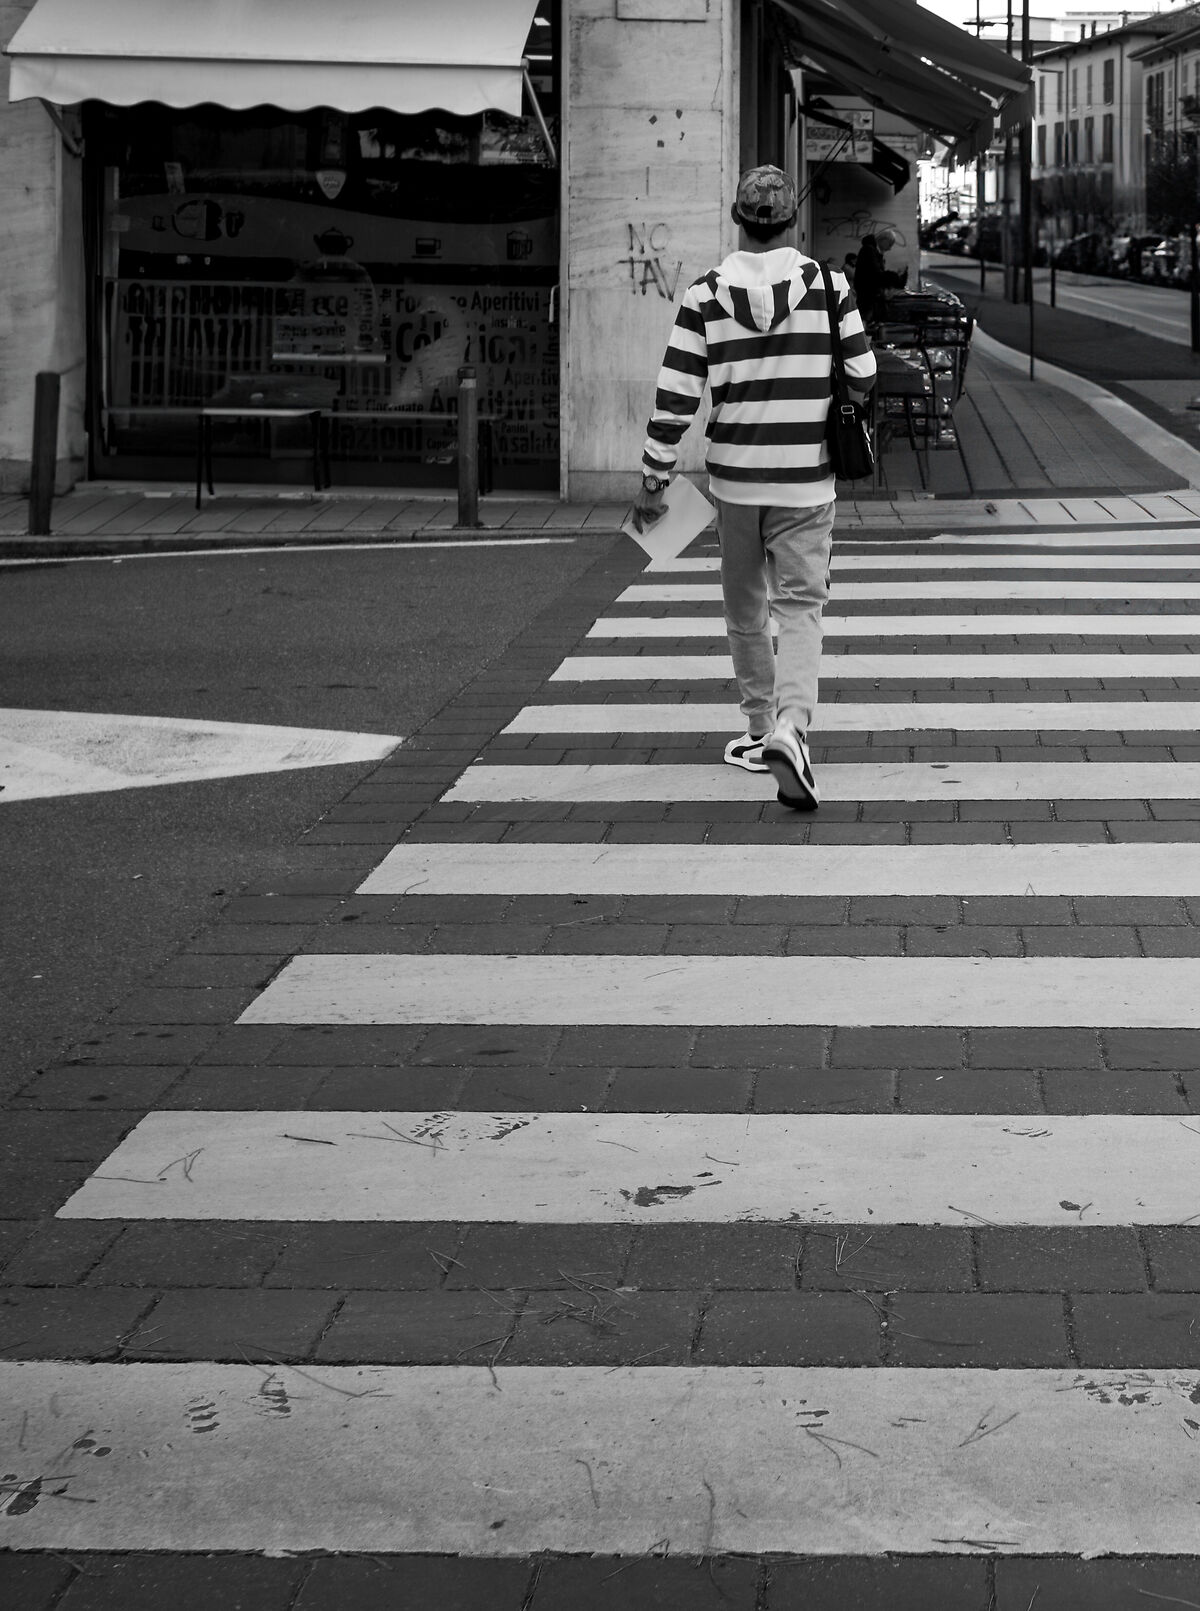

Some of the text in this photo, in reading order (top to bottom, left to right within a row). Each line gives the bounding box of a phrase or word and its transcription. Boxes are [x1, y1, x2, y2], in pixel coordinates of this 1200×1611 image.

[616, 256, 682, 302] TAV
[471, 291, 539, 314] Aperitivi
[430, 388, 536, 425] Apritivi
